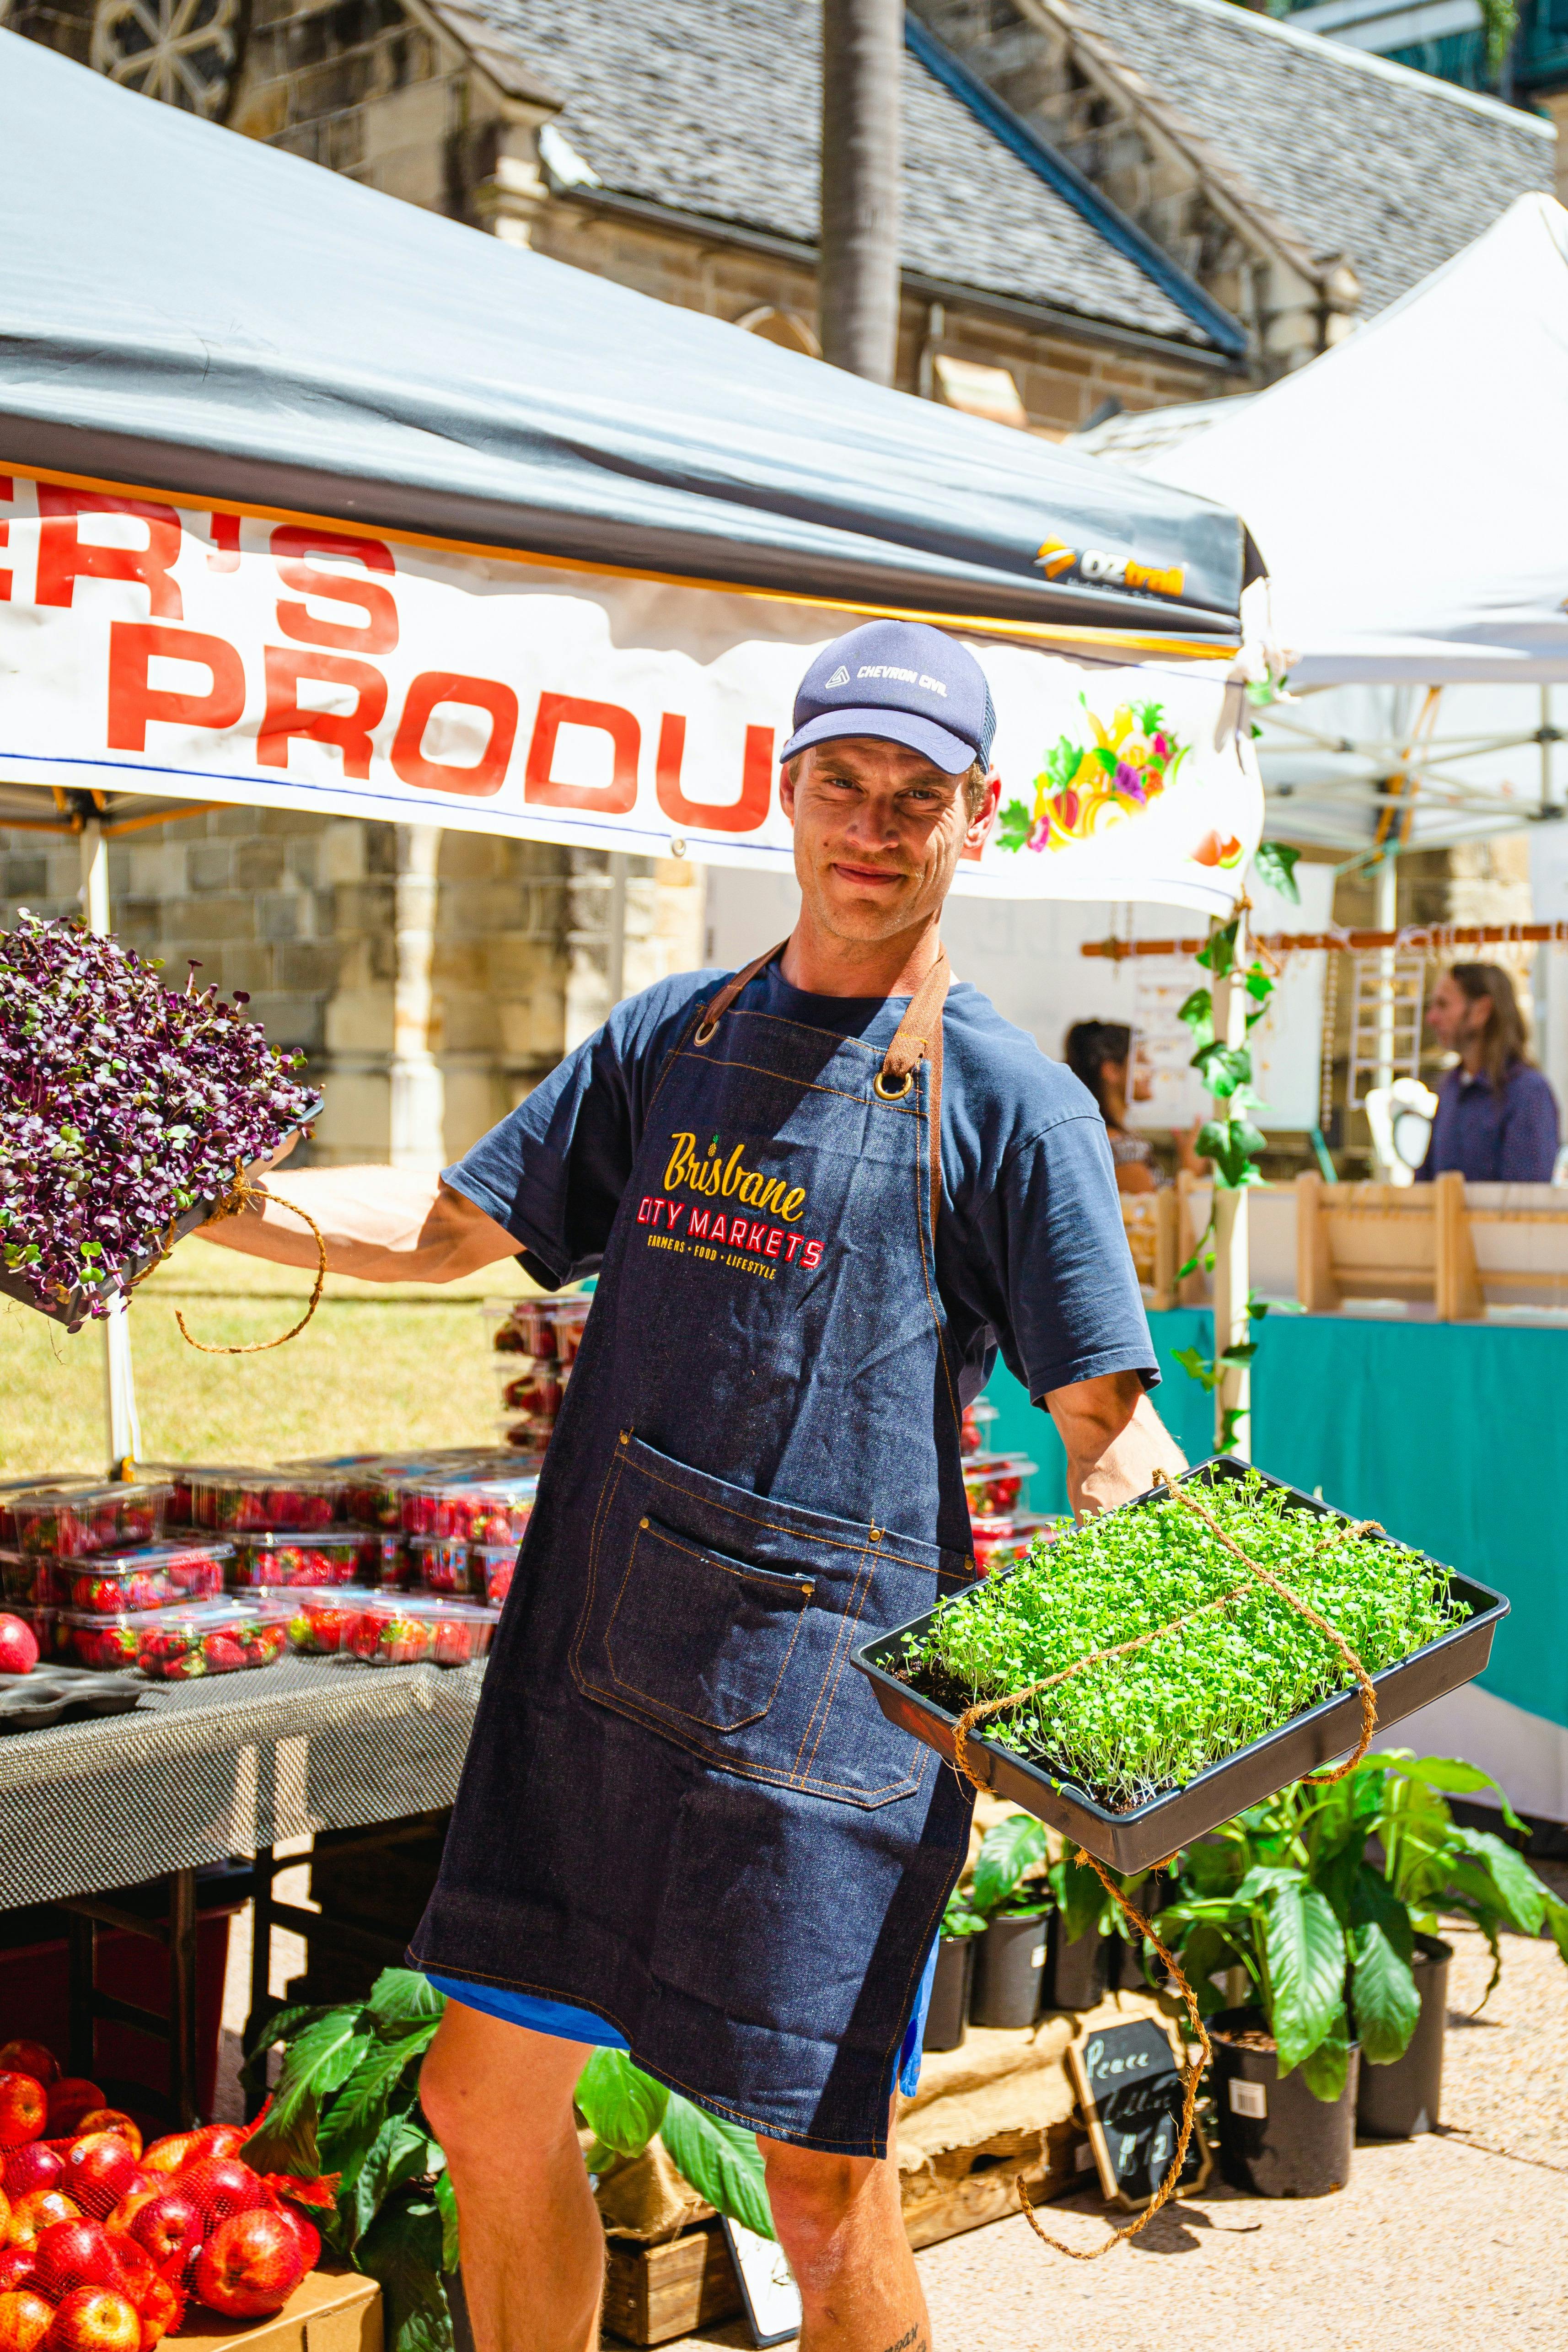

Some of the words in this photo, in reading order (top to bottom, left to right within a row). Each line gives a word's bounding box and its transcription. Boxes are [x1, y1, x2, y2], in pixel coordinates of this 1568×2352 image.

[0, 476, 399, 655] R'S
[857, 665, 918, 684] CHEVRON
[918, 674, 947, 698] CIVIL
[107, 620, 795, 833] PRODU
[664, 1132, 805, 1222] Brisbane
[637, 1196, 685, 1230] CITY
[687, 1207, 825, 1270] MARKETS
[647, 1235, 685, 1253] FARMERS
[693, 1245, 718, 1261] FOOD
[725, 1254, 777, 1280] LIFESTYLE
